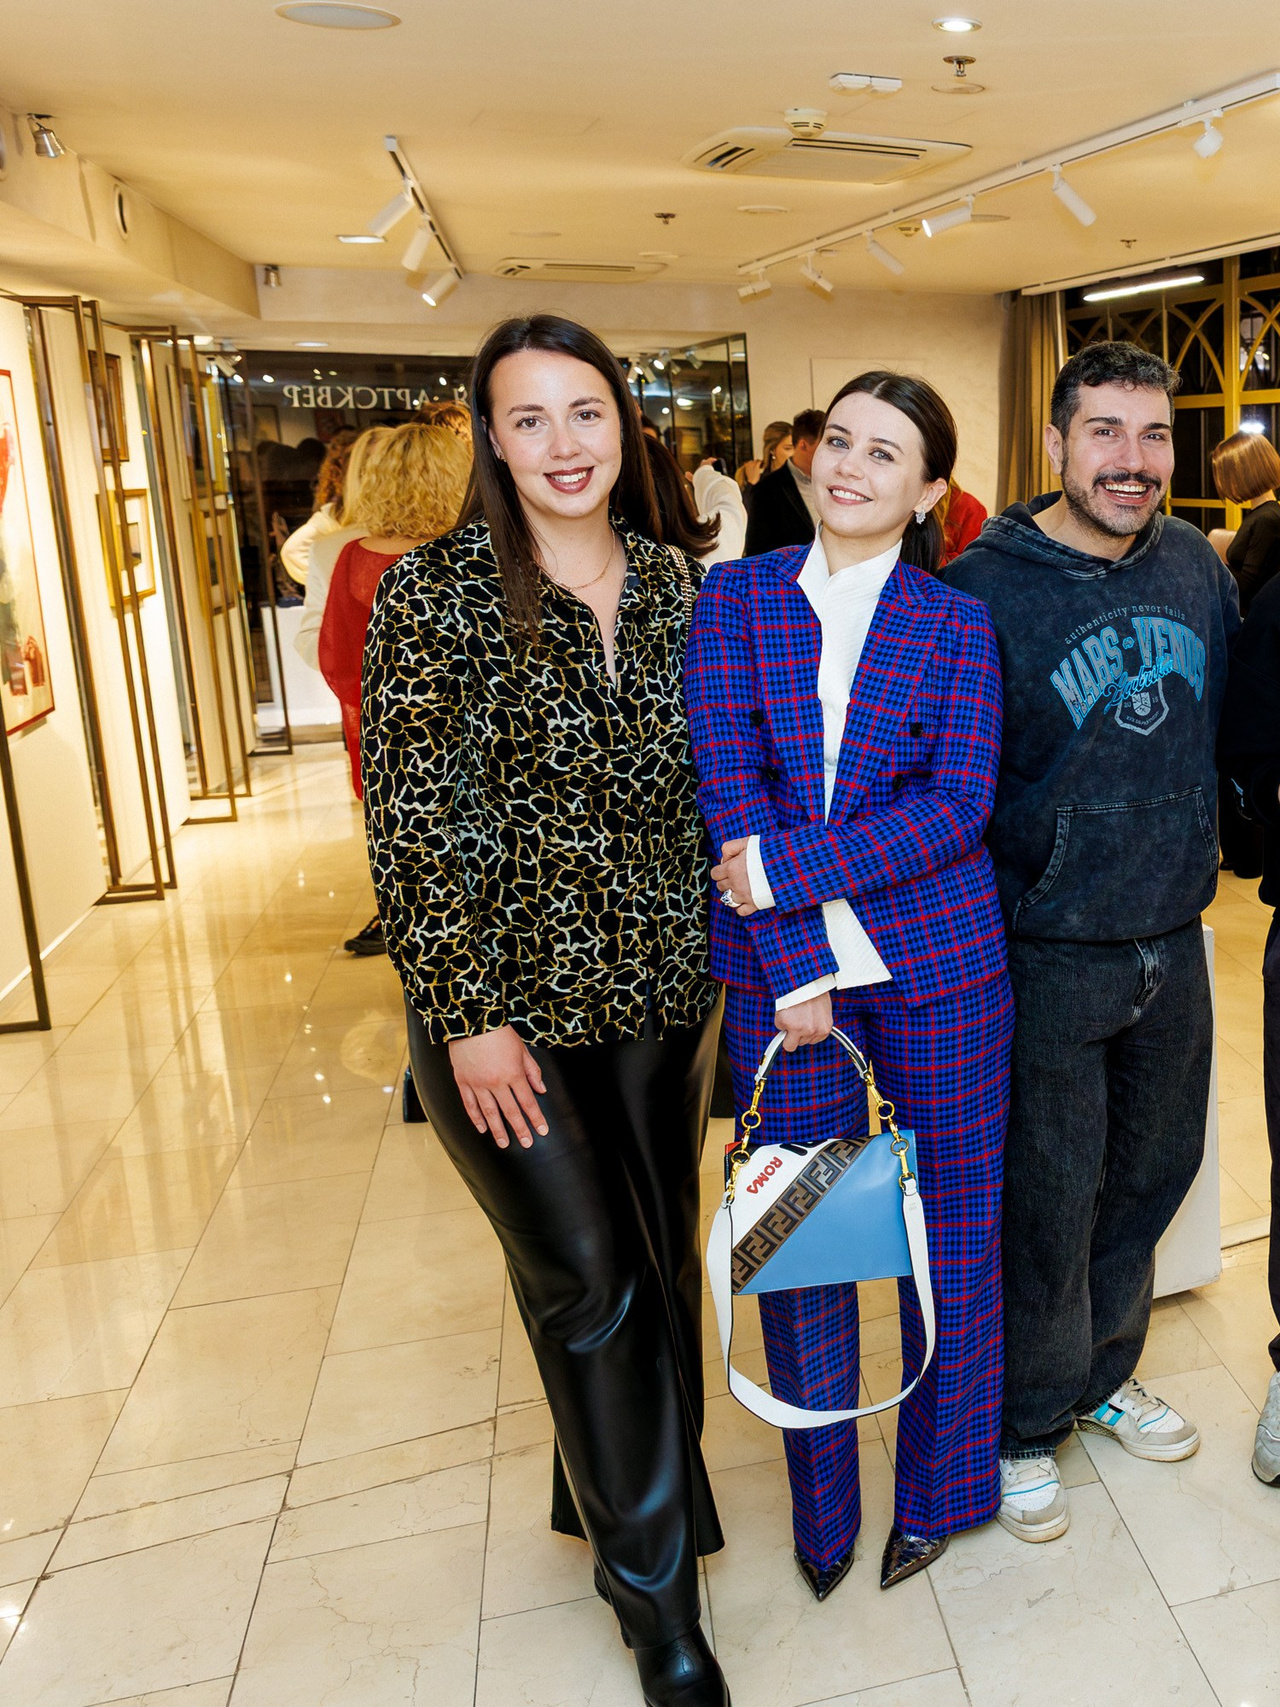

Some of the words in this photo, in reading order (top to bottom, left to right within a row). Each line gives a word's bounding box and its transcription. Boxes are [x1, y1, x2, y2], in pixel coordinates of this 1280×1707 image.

[1064, 607, 1127, 645] authenticity
[1131, 604, 1161, 613] never
[1164, 605, 1186, 621] fails
[1131, 616, 1206, 702] VENUS
